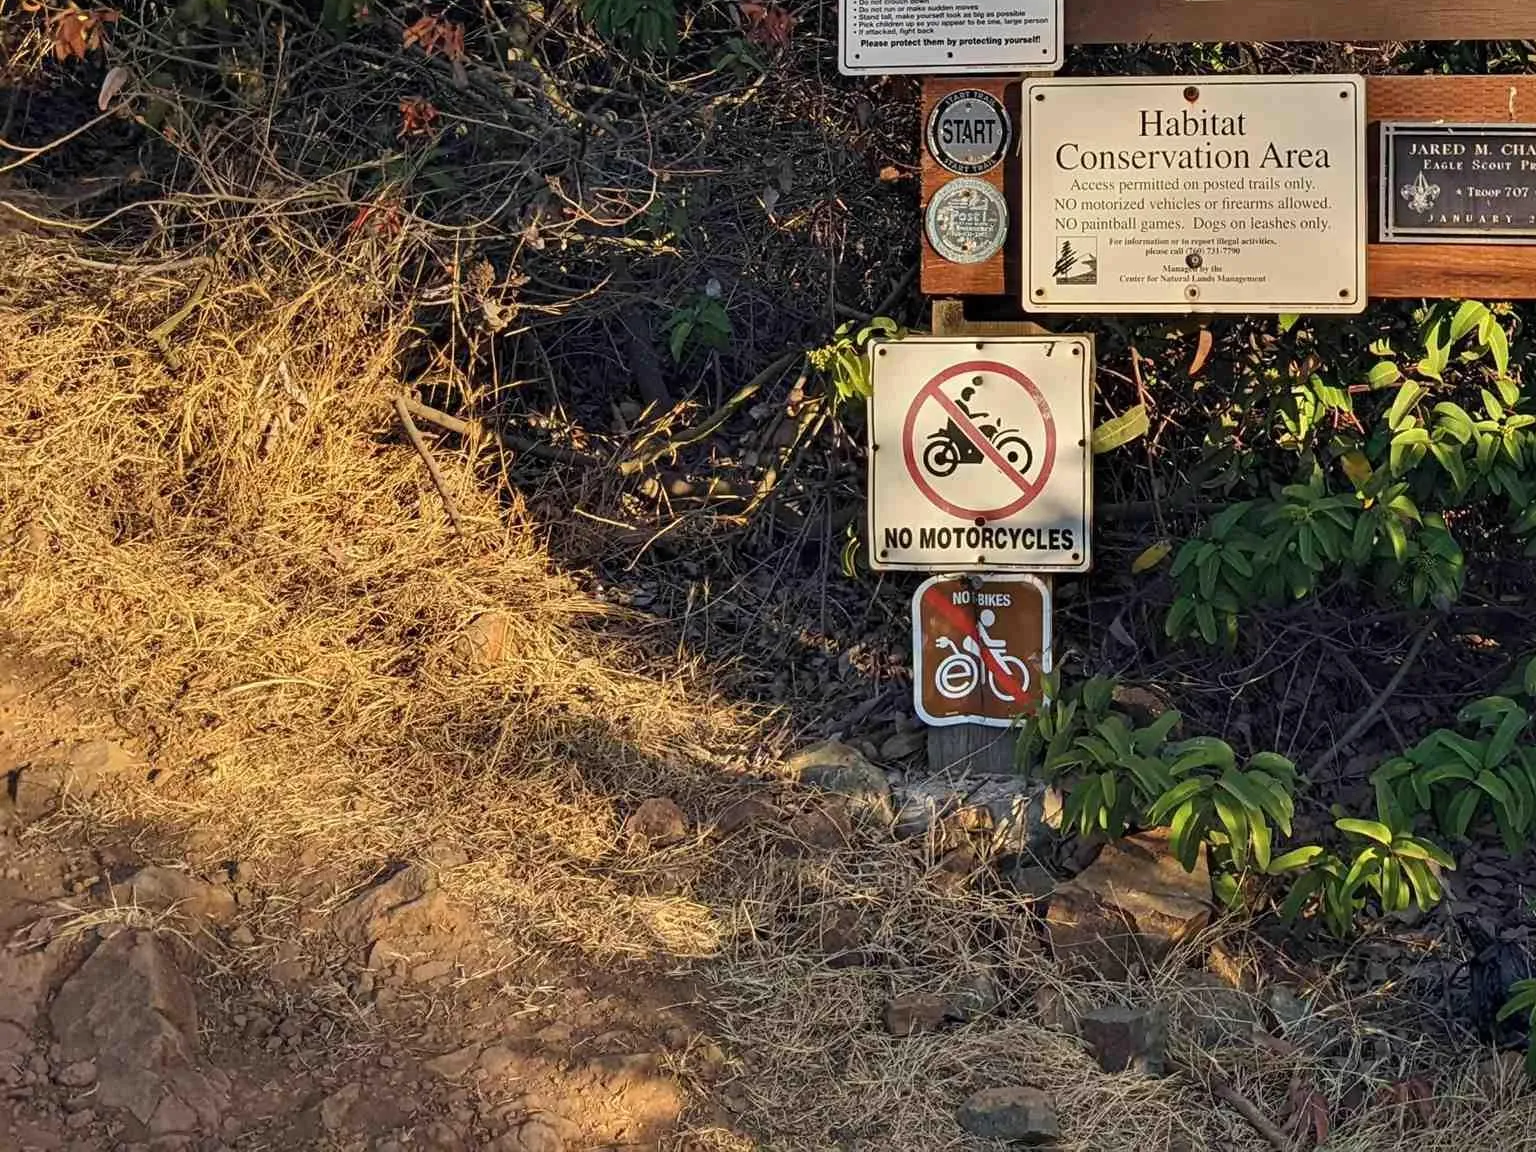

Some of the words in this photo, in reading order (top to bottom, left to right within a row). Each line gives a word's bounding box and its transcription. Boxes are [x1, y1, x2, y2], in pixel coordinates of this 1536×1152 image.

[891, 39, 921, 47] protect
[923, 38, 944, 46] them
[947, 38, 957, 46] by
[959, 37, 1002, 46] protecting
[1139, 109, 1247, 137] Habitat
[943, 119, 996, 144] START
[1056, 142, 1249, 170] Conservation
[1260, 142, 1330, 169] Area
[1409, 144, 1466, 156] JARED
[1475, 144, 1492, 155] M.
[1071, 180, 1115, 192] Access
[1119, 178, 1179, 192] permitted
[1183, 181, 1199, 191] on
[1202, 178, 1244, 192] posted
[1248, 178, 1280, 190] trails
[1284, 177, 1316, 192] only.
[1505, 187, 1529, 198] 707
[1055, 199, 1077, 210] NO
[1080, 197, 1145, 211] motorized
[1149, 197, 1201, 210] vehicles
[1205, 200, 1218, 209] or
[1222, 197, 1274, 210] firearms
[1278, 197, 1332, 209] allowed.
[1055, 218, 1077, 230] NO
[1080, 217, 1136, 233] paintball
[1141, 219, 1184, 232] games.
[1193, 217, 1226, 231] Dogs
[1230, 219, 1246, 229] on
[1250, 217, 1296, 229] leashes
[1300, 217, 1331, 231] only.
[885, 528, 912, 548] NO
[920, 528, 1074, 550] MOTORCYCLES
[952, 591, 970, 605] NO
